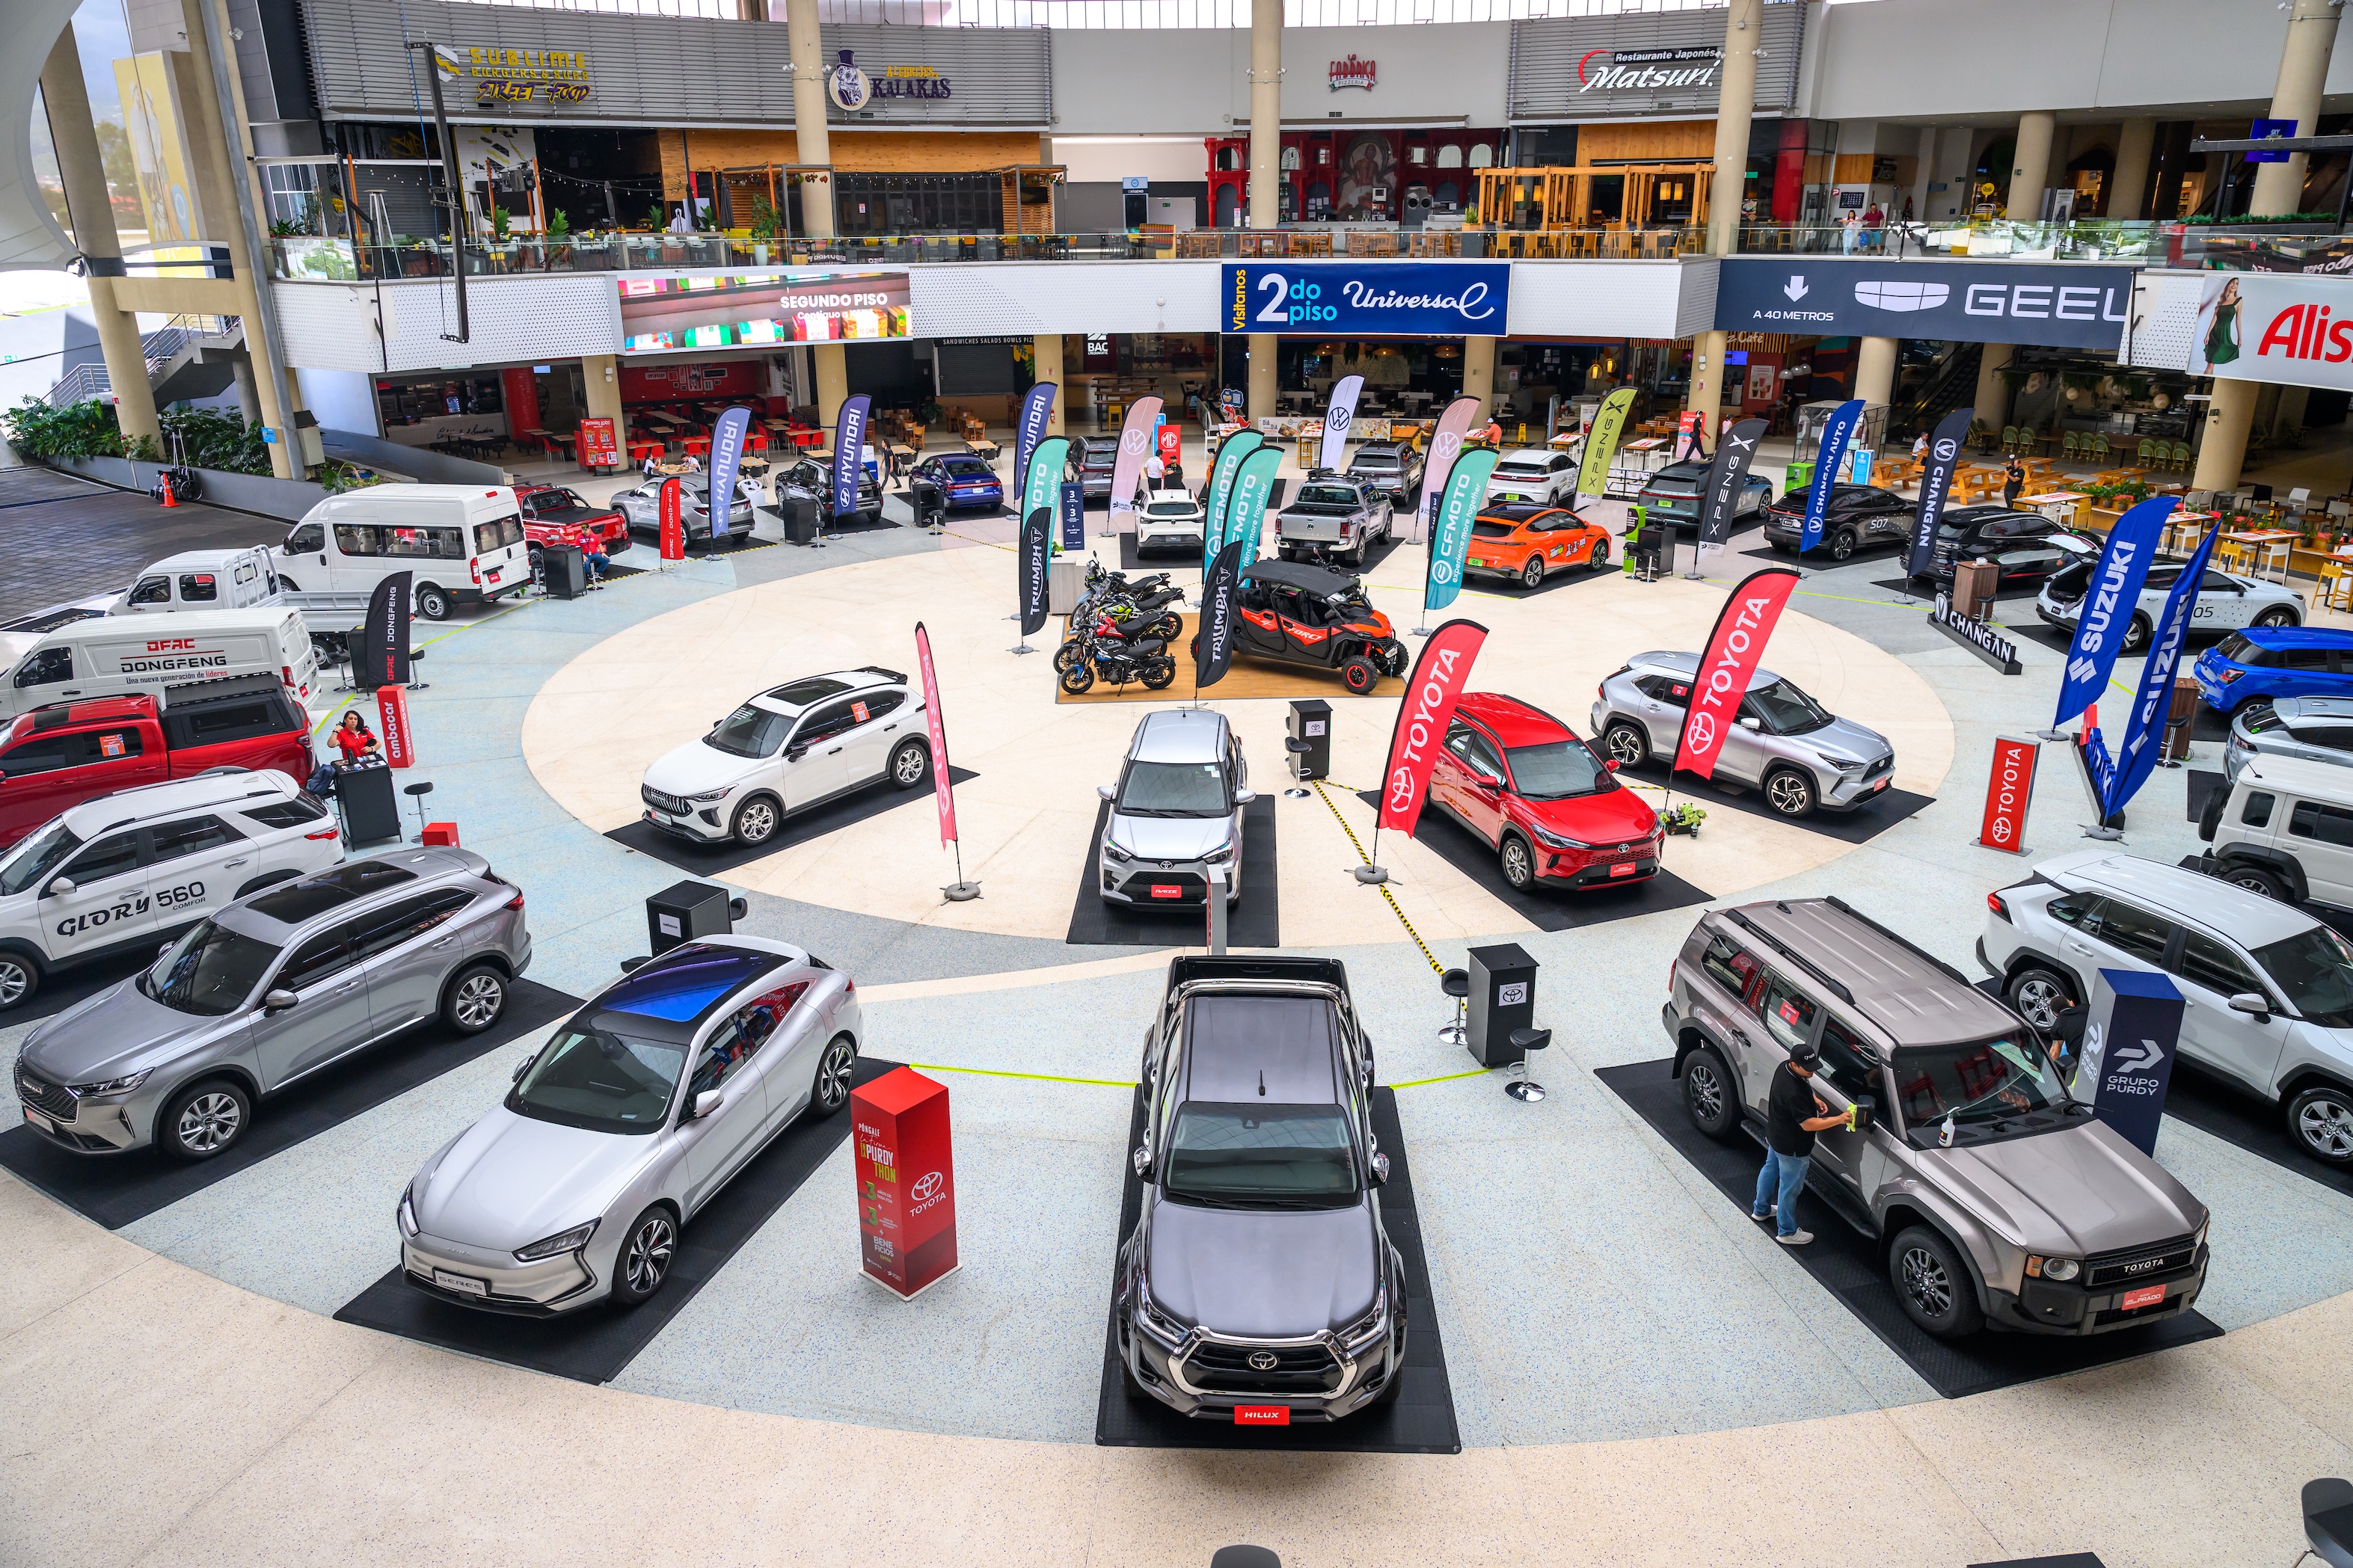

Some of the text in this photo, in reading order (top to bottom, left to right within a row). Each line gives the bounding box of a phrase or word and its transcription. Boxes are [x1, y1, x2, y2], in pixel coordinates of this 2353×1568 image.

[470, 47, 586, 69] SUBLIME
[1615, 48, 1716, 63] Restaurante Japonés
[470, 66, 589, 81] BURGERS & SUBS
[886, 65, 934, 79] ALEBRIJES
[475, 79, 592, 105] STREET FOOD
[871, 78, 951, 99] KALAKAS
[780, 292, 888, 309] SEGUNDO PISO
[1233, 269, 1247, 330] Visitanos
[1256, 273, 1321, 322] 2 do
[1343, 281, 1495, 320] Universal
[797, 310, 841, 320] Contiguo
[1290, 301, 1337, 326] piso
[1752, 310, 1834, 322] A 40 METROS
[1087, 342, 1108, 352] BAC
[840, 408, 862, 484] HYUNDAI
[1162, 433, 1177, 448] MG
[1588, 418, 1613, 488] XPENG
[1815, 419, 1846, 514] CHANGAN AUTO
[1048, 470, 1059, 505] together
[1070, 491, 1076, 499] 3
[1214, 454, 1238, 532] CFMOTO
[1709, 455, 1741, 535] XPENG
[1070, 508, 1076, 517] 3
[1256, 482, 1268, 520] together
[1918, 466, 1945, 547] CHANGAN
[1441, 474, 1471, 557] CFMOTO
[1870, 518, 1889, 529] S07
[1452, 550, 1467, 583] experience
[1467, 482, 1482, 523] together
[1030, 544, 1044, 615] TRIUMPH
[2080, 539, 2137, 654] SUZUKI
[387, 585, 396, 643] DONGFENG
[1212, 585, 1229, 663] TRIUMPH
[147, 638, 196, 652] DFAC
[1949, 612, 2013, 664] CHANGAN
[120, 656, 227, 674] DONGFENG
[1702, 598, 1770, 708] TOYOTA
[140, 675, 159, 684] nueva
[160, 671, 196, 683] generación
[197, 671, 204, 680] de
[205, 669, 228, 678] líderes
[1403, 648, 1461, 762] TOYOTA
[384, 701, 401, 759] ambacar
[399, 698, 412, 756] ambacar
[1997, 748, 2022, 815] TOYOTA
[56, 882, 205, 937] GLORY 560
[173, 897, 206, 911] COMFOR
[2081, 1060, 2096, 1084] PURDY
[2083, 1050, 2097, 1076] GRUPO
[2106, 1084, 2158, 1095] PURDY
[2108, 1075, 2159, 1088] GRUPO
[858, 1122, 880, 1137] PÓNGALE
[866, 1143, 894, 1167] PURDY
[874, 1161, 897, 1184] THON
[865, 1180, 877, 1201] 3
[867, 1205, 879, 1226] 3
[909, 1191, 947, 1217] TOYOTA
[873, 1235, 894, 1250] BENE
[874, 1243, 895, 1258] FICIOS
[2124, 1258, 2164, 1273] TOYOTA
[438, 1276, 482, 1291] SERES
[2137, 1294, 2162, 1303] PRADO
[1245, 1411, 1280, 1419] HILUX
